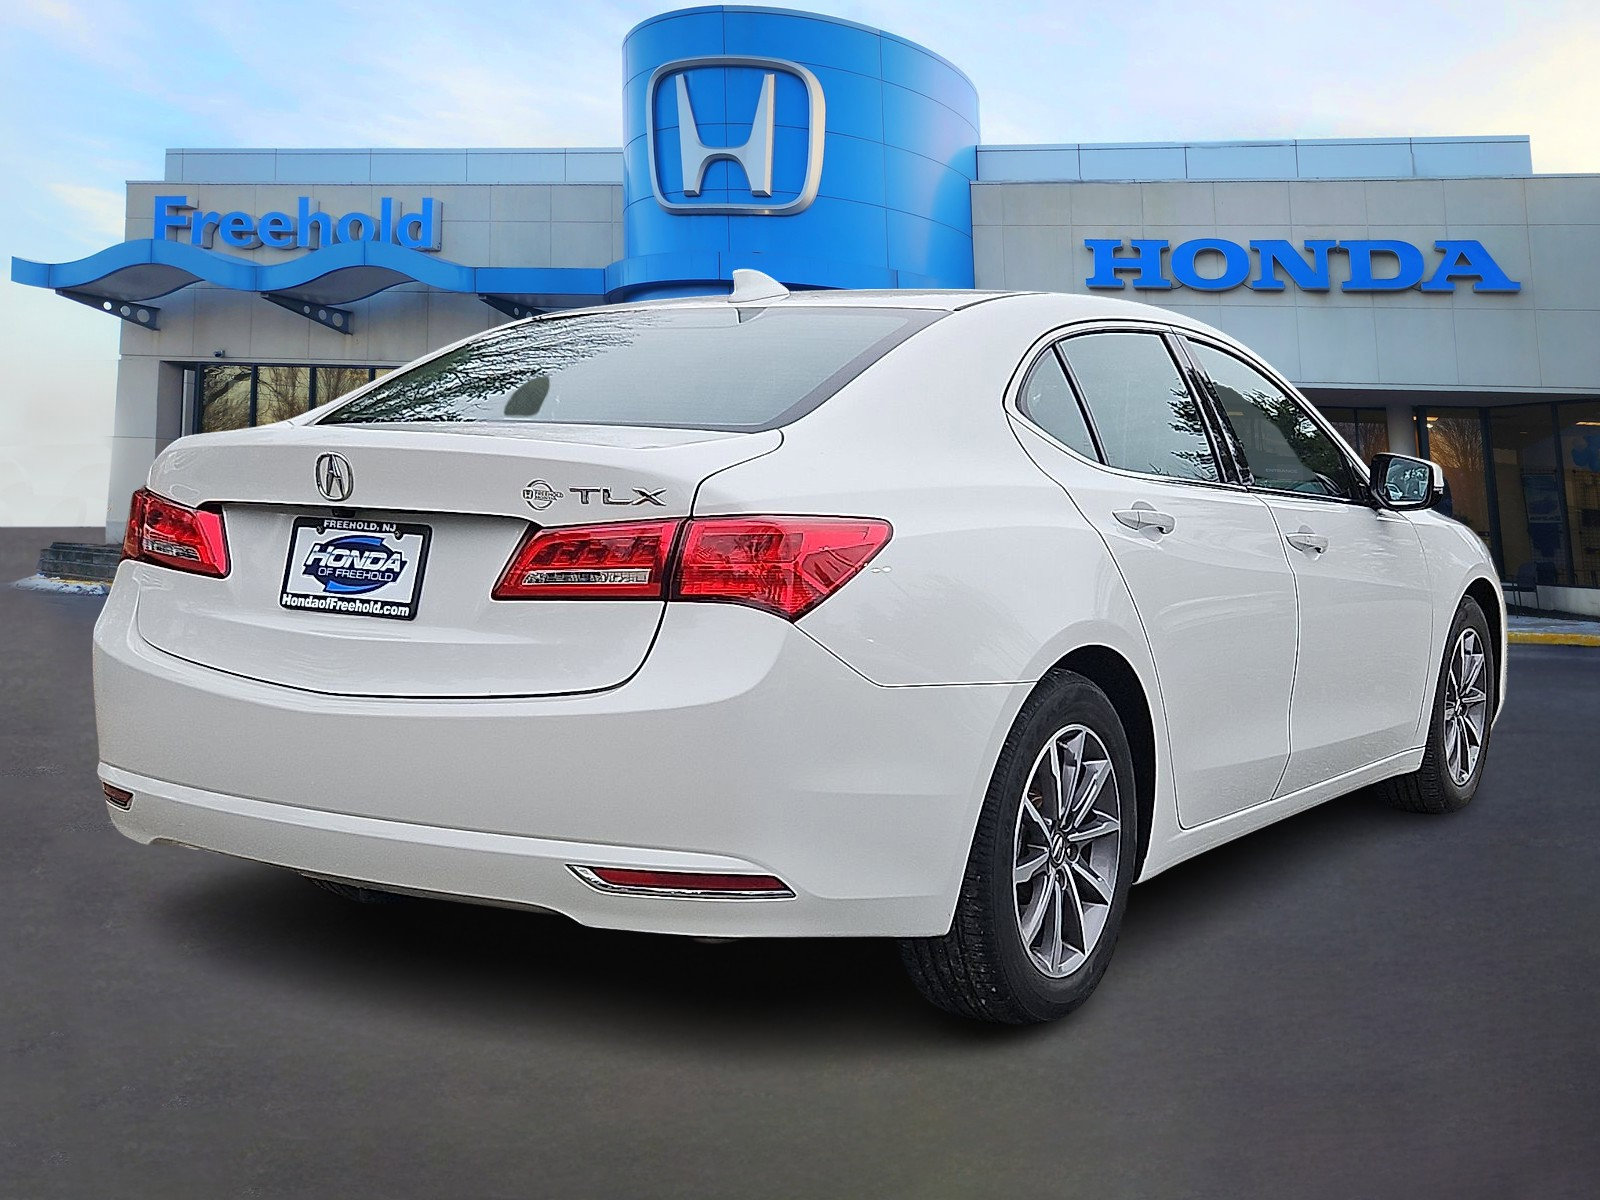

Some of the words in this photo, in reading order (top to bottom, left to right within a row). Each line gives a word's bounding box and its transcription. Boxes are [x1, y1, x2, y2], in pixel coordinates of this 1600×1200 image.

[153, 196, 437, 249] Freehold
[1084, 238, 1521, 293] HONDA
[569, 486, 667, 506] TLX
[324, 519, 379, 531] FREEHOLD,
[382, 523, 396, 532] NJ
[305, 545, 402, 572] HONDA
[318, 567, 333, 576] OF
[335, 568, 394, 582] FREEHOLD
[281, 593, 410, 616] HondaofFreehold.com
